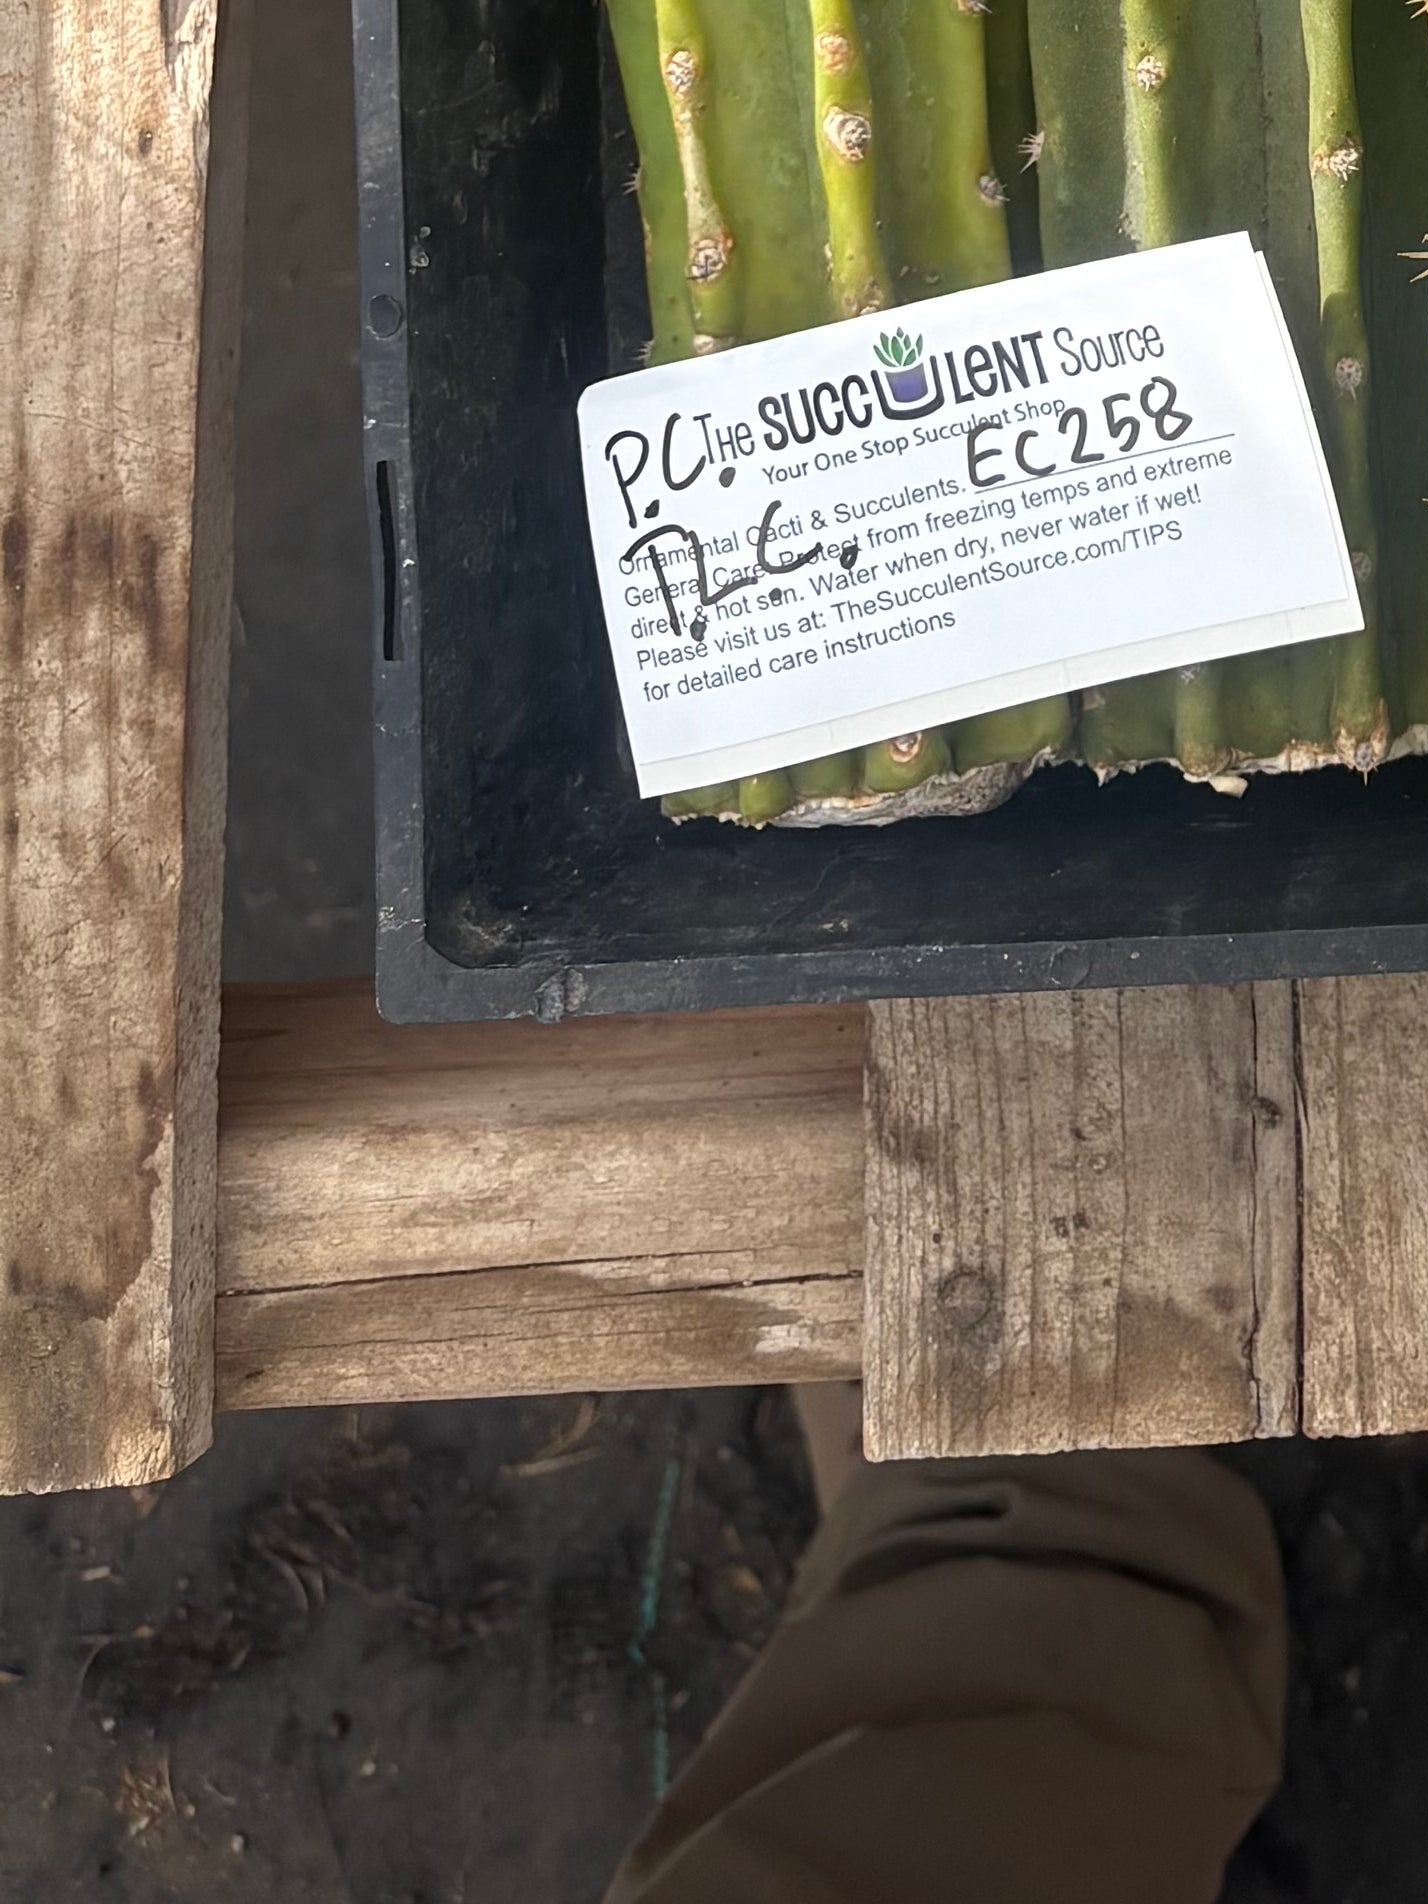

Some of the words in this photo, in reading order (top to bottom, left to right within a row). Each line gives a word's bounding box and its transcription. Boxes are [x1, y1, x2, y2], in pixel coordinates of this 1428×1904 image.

[1053, 325, 1164, 376] Source
[762, 462, 808, 484] Your
[814, 450, 857, 471] One
[861, 437, 908, 459] Stop
[913, 409, 1011, 446] Succulent
[1014, 400, 1068, 421] Shop
[967, 377, 1192, 486] EC258
[625, 569, 707, 607] Genera
[867, 523, 919, 548] from
[925, 499, 1015, 532] freezing
[1021, 482, 1089, 509] temps
[1097, 465, 1137, 491] and
[1144, 450, 1231, 481] extreme
[631, 609, 687, 639] diret
[693, 602, 710, 627] &
[714, 596, 751, 620] hot
[809, 565, 878, 596] Water
[885, 548, 947, 575] when
[955, 537, 994, 558] dry,
[1001, 519, 1062, 546] never
[1069, 504, 1129, 530] water
[1136, 495, 1148, 515] if
[1155, 484, 1201, 510] wet!
[746, 516, 803, 547] Cacti
[811, 510, 828, 530] &
[834, 479, 965, 523] Succulents.
[637, 634, 708, 670] Please
[714, 627, 759, 652] visit
[764, 623, 791, 641] us
[798, 611, 826, 633] at:
[830, 521, 1182, 622] TheSucculentSource.com/TIPS
[644, 682, 670, 701] for
[678, 658, 762, 694] detailed
[770, 649, 817, 673] care
[824, 612, 955, 659] instructions
